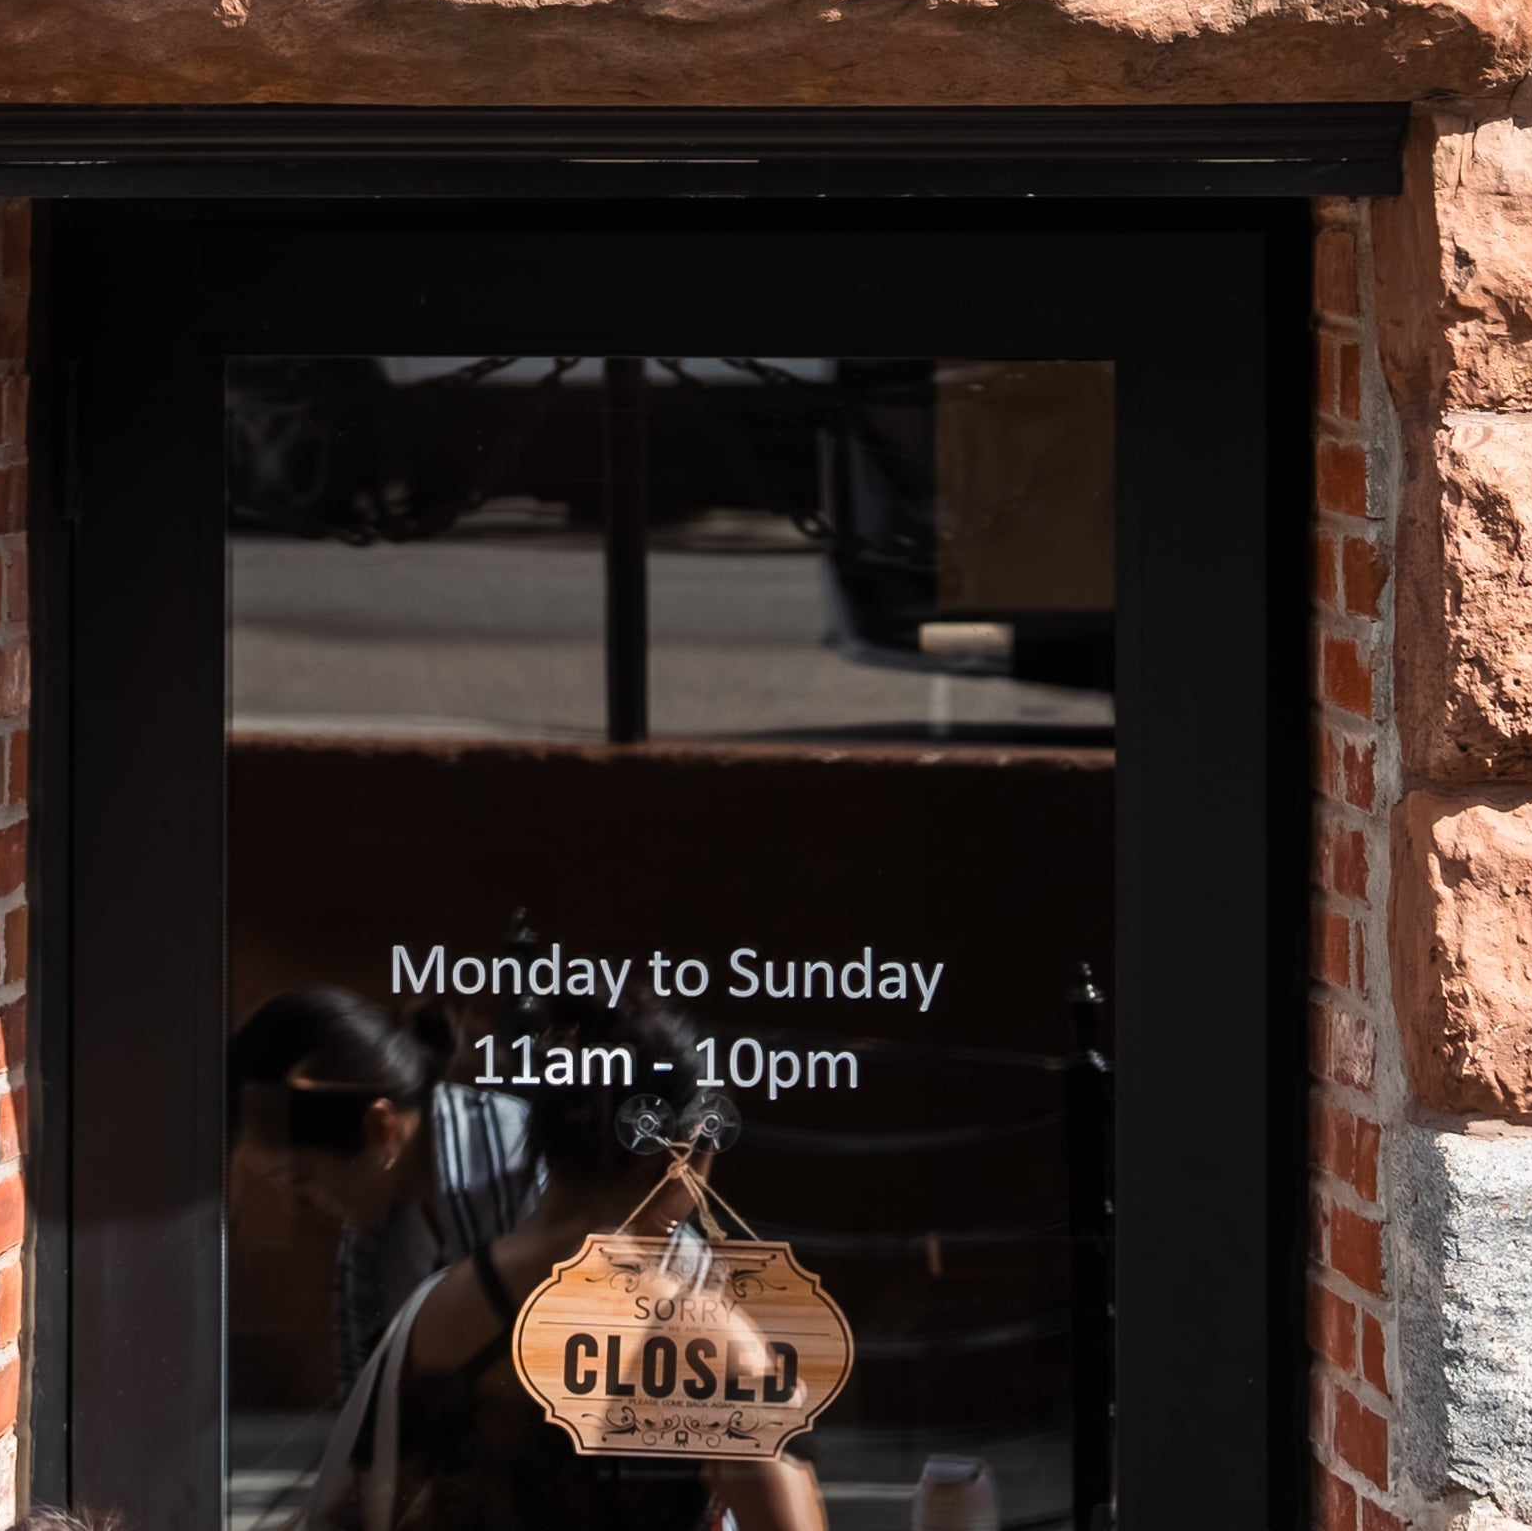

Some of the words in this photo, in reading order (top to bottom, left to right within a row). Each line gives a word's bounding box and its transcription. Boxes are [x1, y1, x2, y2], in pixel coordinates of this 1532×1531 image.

[391, 944, 631, 1008] Monday
[649, 950, 709, 997] to
[728, 947, 944, 1012] Sunday
[474, 1035, 634, 1086] 11am
[695, 1038, 859, 1100] 10pm
[634, 1296, 737, 1323] SORRY
[563, 1333, 798, 1403] CLOSED
